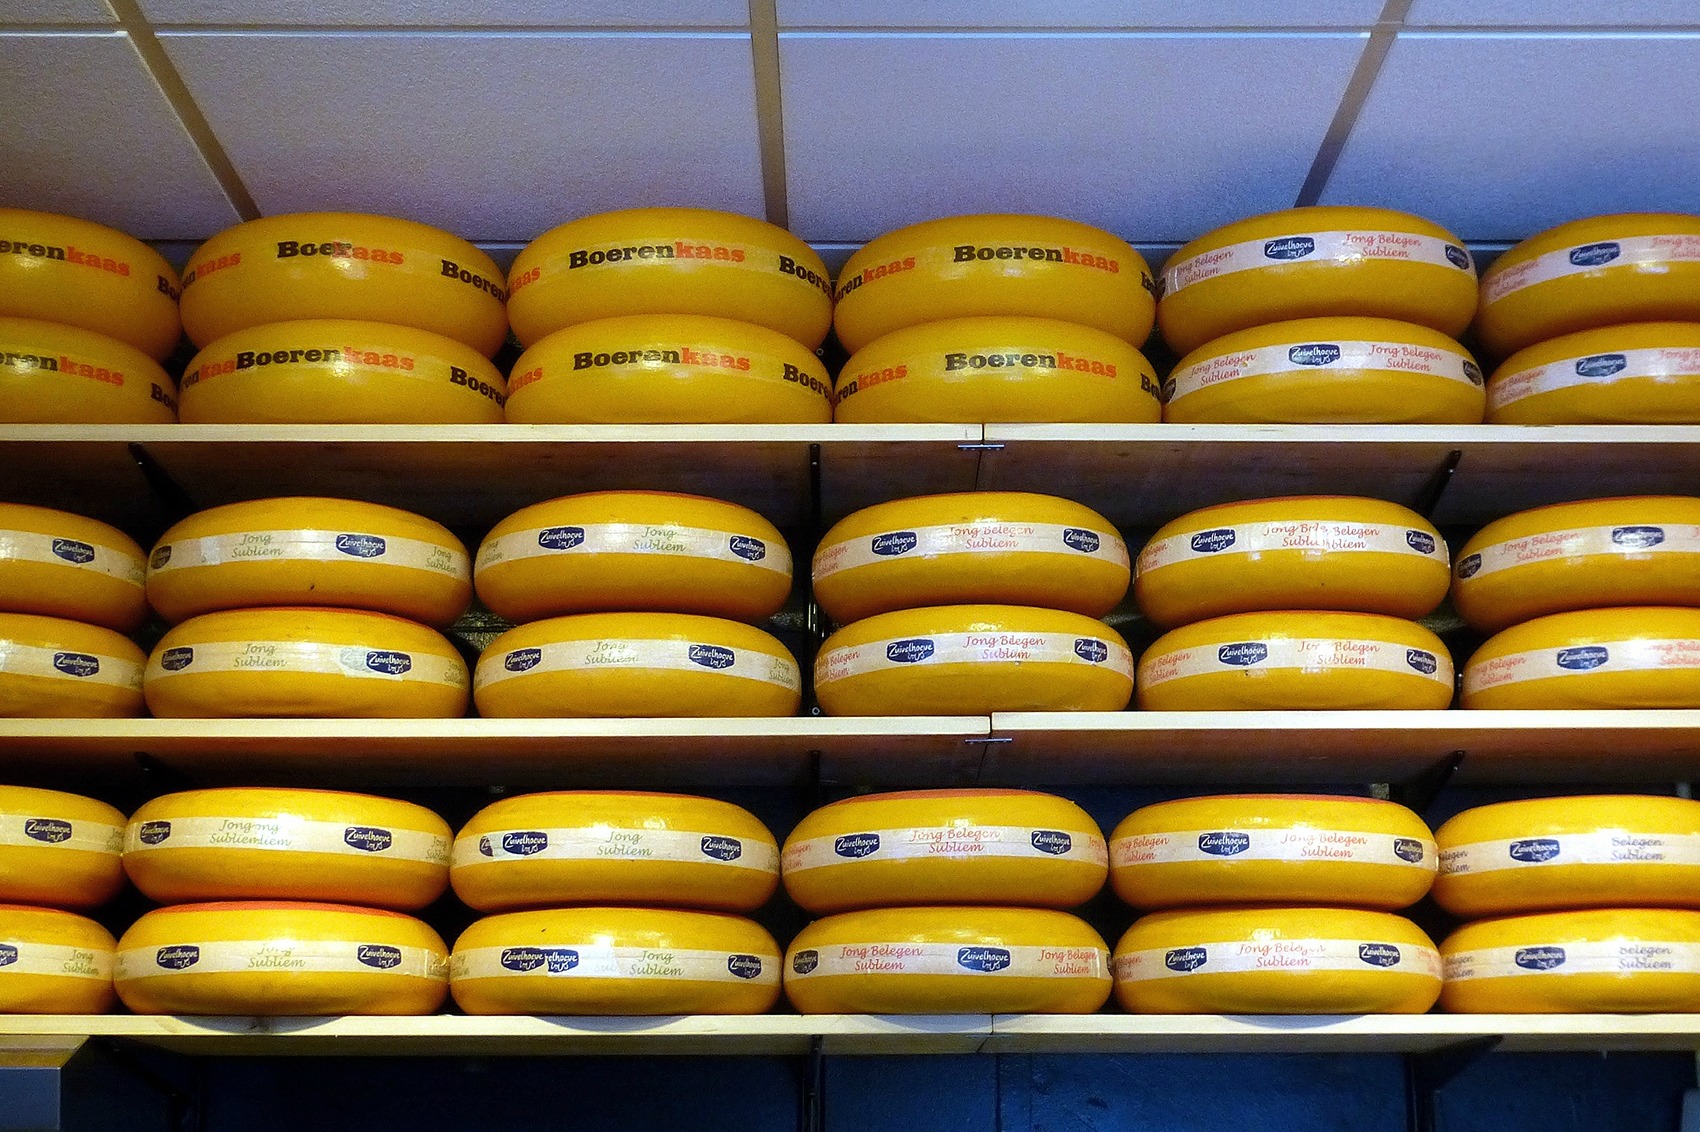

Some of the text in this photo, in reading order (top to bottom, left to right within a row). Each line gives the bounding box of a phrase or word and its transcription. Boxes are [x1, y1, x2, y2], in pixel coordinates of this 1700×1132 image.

[1378, 234, 1422, 248] Belegen
[569, 241, 746, 269] Boerenkaas
[1362, 245, 1409, 258] Subliem
[953, 246, 1120, 274] Boerenkaas
[1195, 251, 1234, 267] Belegen
[236, 346, 415, 372] Boerenkaas
[573, 347, 751, 371] Boerenkaas
[1368, 345, 1442, 360] Jong Belegen
[945, 352, 1118, 378] Boerenkaas
[1214, 354, 1257, 368] Belegen
[1387, 359, 1431, 371] Subliem
[1201, 369, 1241, 385] Subliem
[239, 534, 274, 545] Jong
[540, 530, 583, 543] Zuivelhoeve
[641, 527, 677, 539] Jong
[338, 536, 384, 549] Zuivelhoeve
[633, 540, 686, 552] Subliem
[874, 537, 915, 550] Zuivelhoeve
[965, 539, 1019, 549] Subliem
[1193, 533, 1234, 547] Zuivelhoeve
[232, 547, 284, 558] Subliem
[1501, 541, 1529, 555] Jong
[963, 636, 999, 647] Jong
[242, 643, 278, 655] Jong
[690, 646, 733, 660] Zuivelhoeve
[889, 643, 932, 657] Zuivelhoeve
[1220, 646, 1266, 659] Zuivelhoeve
[233, 656, 288, 668] Subliem
[368, 653, 411, 666] Zuivelhoeve
[347, 828, 390, 842] Zuivelhoeve
[505, 834, 546, 847] Zuivelhoeve
[606, 831, 643, 843] Jong
[909, 829, 1000, 842] Jong Belegen
[1033, 832, 1070, 845] Zuivelhoeve
[1201, 834, 1248, 848] Zuivelhoeve
[1319, 833, 1367, 847] Belegen
[837, 837, 878, 851] Zuivelhoeve
[929, 842, 984, 853] Subliem
[1133, 836, 1169, 849] Belegen
[597, 845, 653, 856] Subliem
[1300, 845, 1353, 858] Subliem
[69, 949, 95, 961] Jong
[503, 950, 544, 962] Zuivelhoeve
[639, 950, 674, 962] Jong
[840, 945, 923, 959] Jong Belegen
[960, 949, 1009, 962] Zuivelhoeve
[1038, 949, 1065, 962] Jong
[1236, 943, 1273, 957] Jong
[248, 957, 306, 968] Subliem
[855, 959, 906, 971] Subliem
[1054, 961, 1090, 975] Subliem
[1256, 956, 1311, 968] Subliem
[629, 964, 685, 976] Subliem
